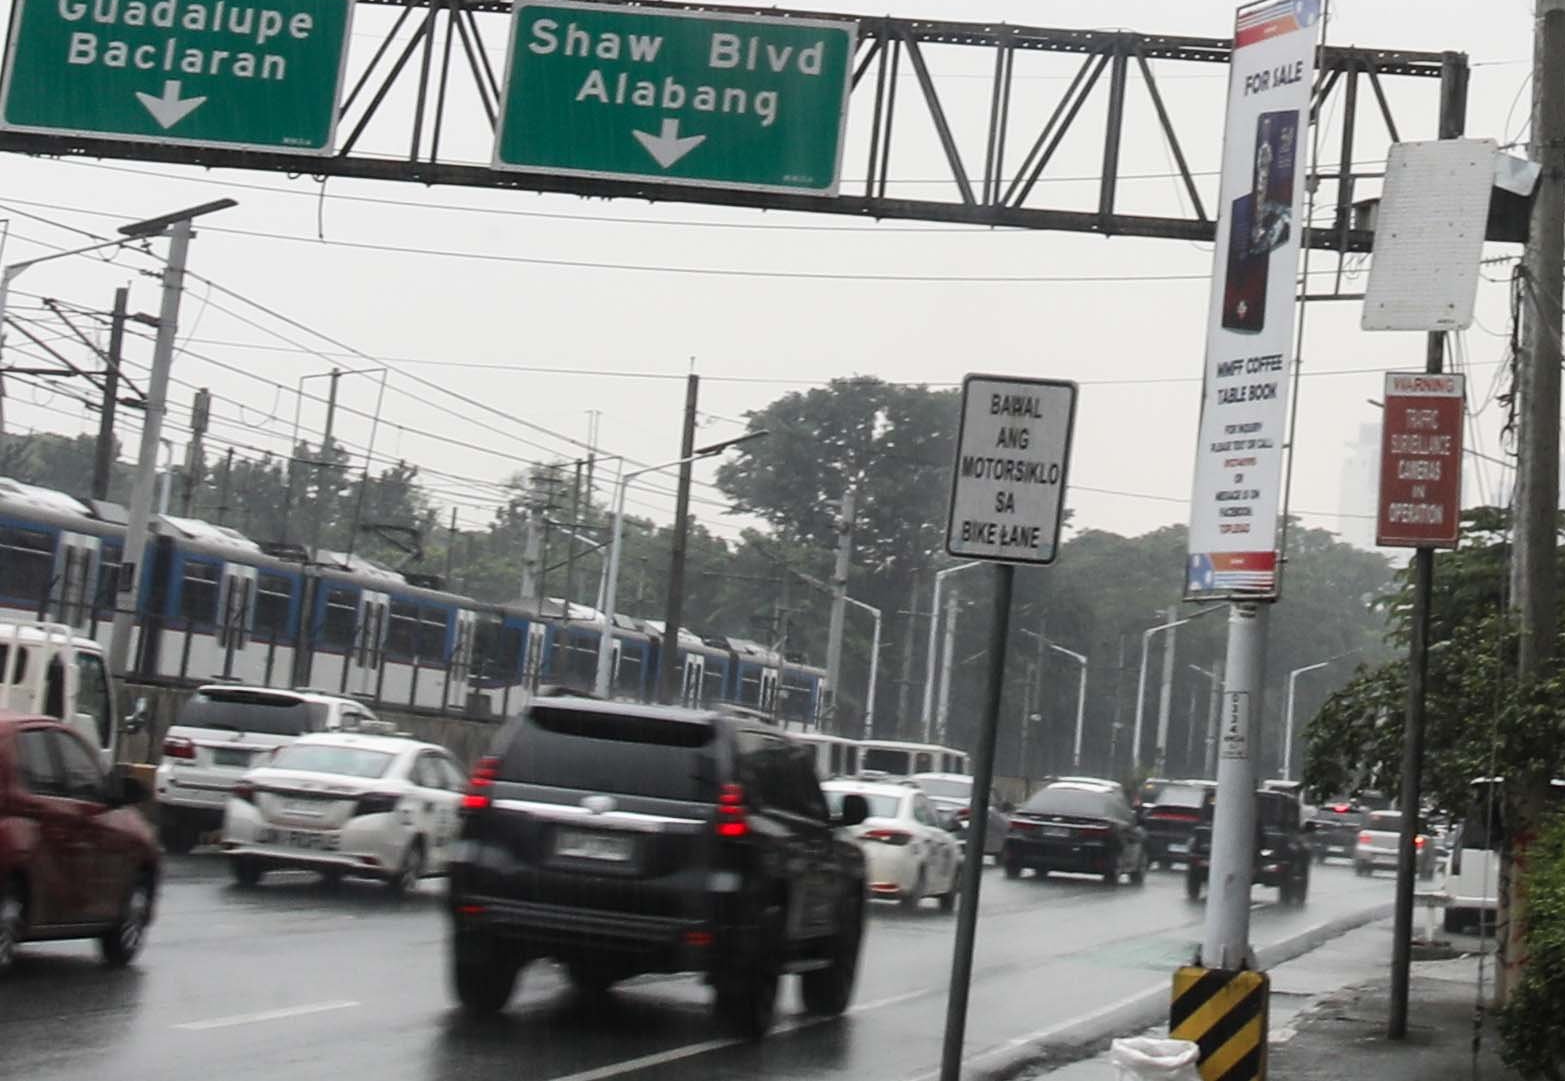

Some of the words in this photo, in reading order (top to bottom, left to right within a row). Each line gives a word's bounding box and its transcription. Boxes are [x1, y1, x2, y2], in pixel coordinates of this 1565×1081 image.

[68, 32, 286, 80] Baclaran
[528, 19, 665, 62] Shaw
[709, 33, 825, 76] Blvd
[1244, 70, 1271, 96] FOR
[1273, 61, 1303, 88] SALE
[575, 70, 779, 127] Alabang
[1246, 353, 1282, 374] COFFEE
[1217, 386, 1247, 405] TABLE
[1248, 382, 1277, 401] BOOK
[1393, 377, 1455, 393] WARNING
[990, 394, 1043, 418] BAWAL
[996, 428, 1030, 450] ANG
[961, 456, 1060, 485] MOTORSIKLO
[995, 491, 1016, 513] SA
[1412, 485, 1426, 499] IN
[961, 521, 997, 545] BIKE
[1000, 525, 1040, 548] LANE
